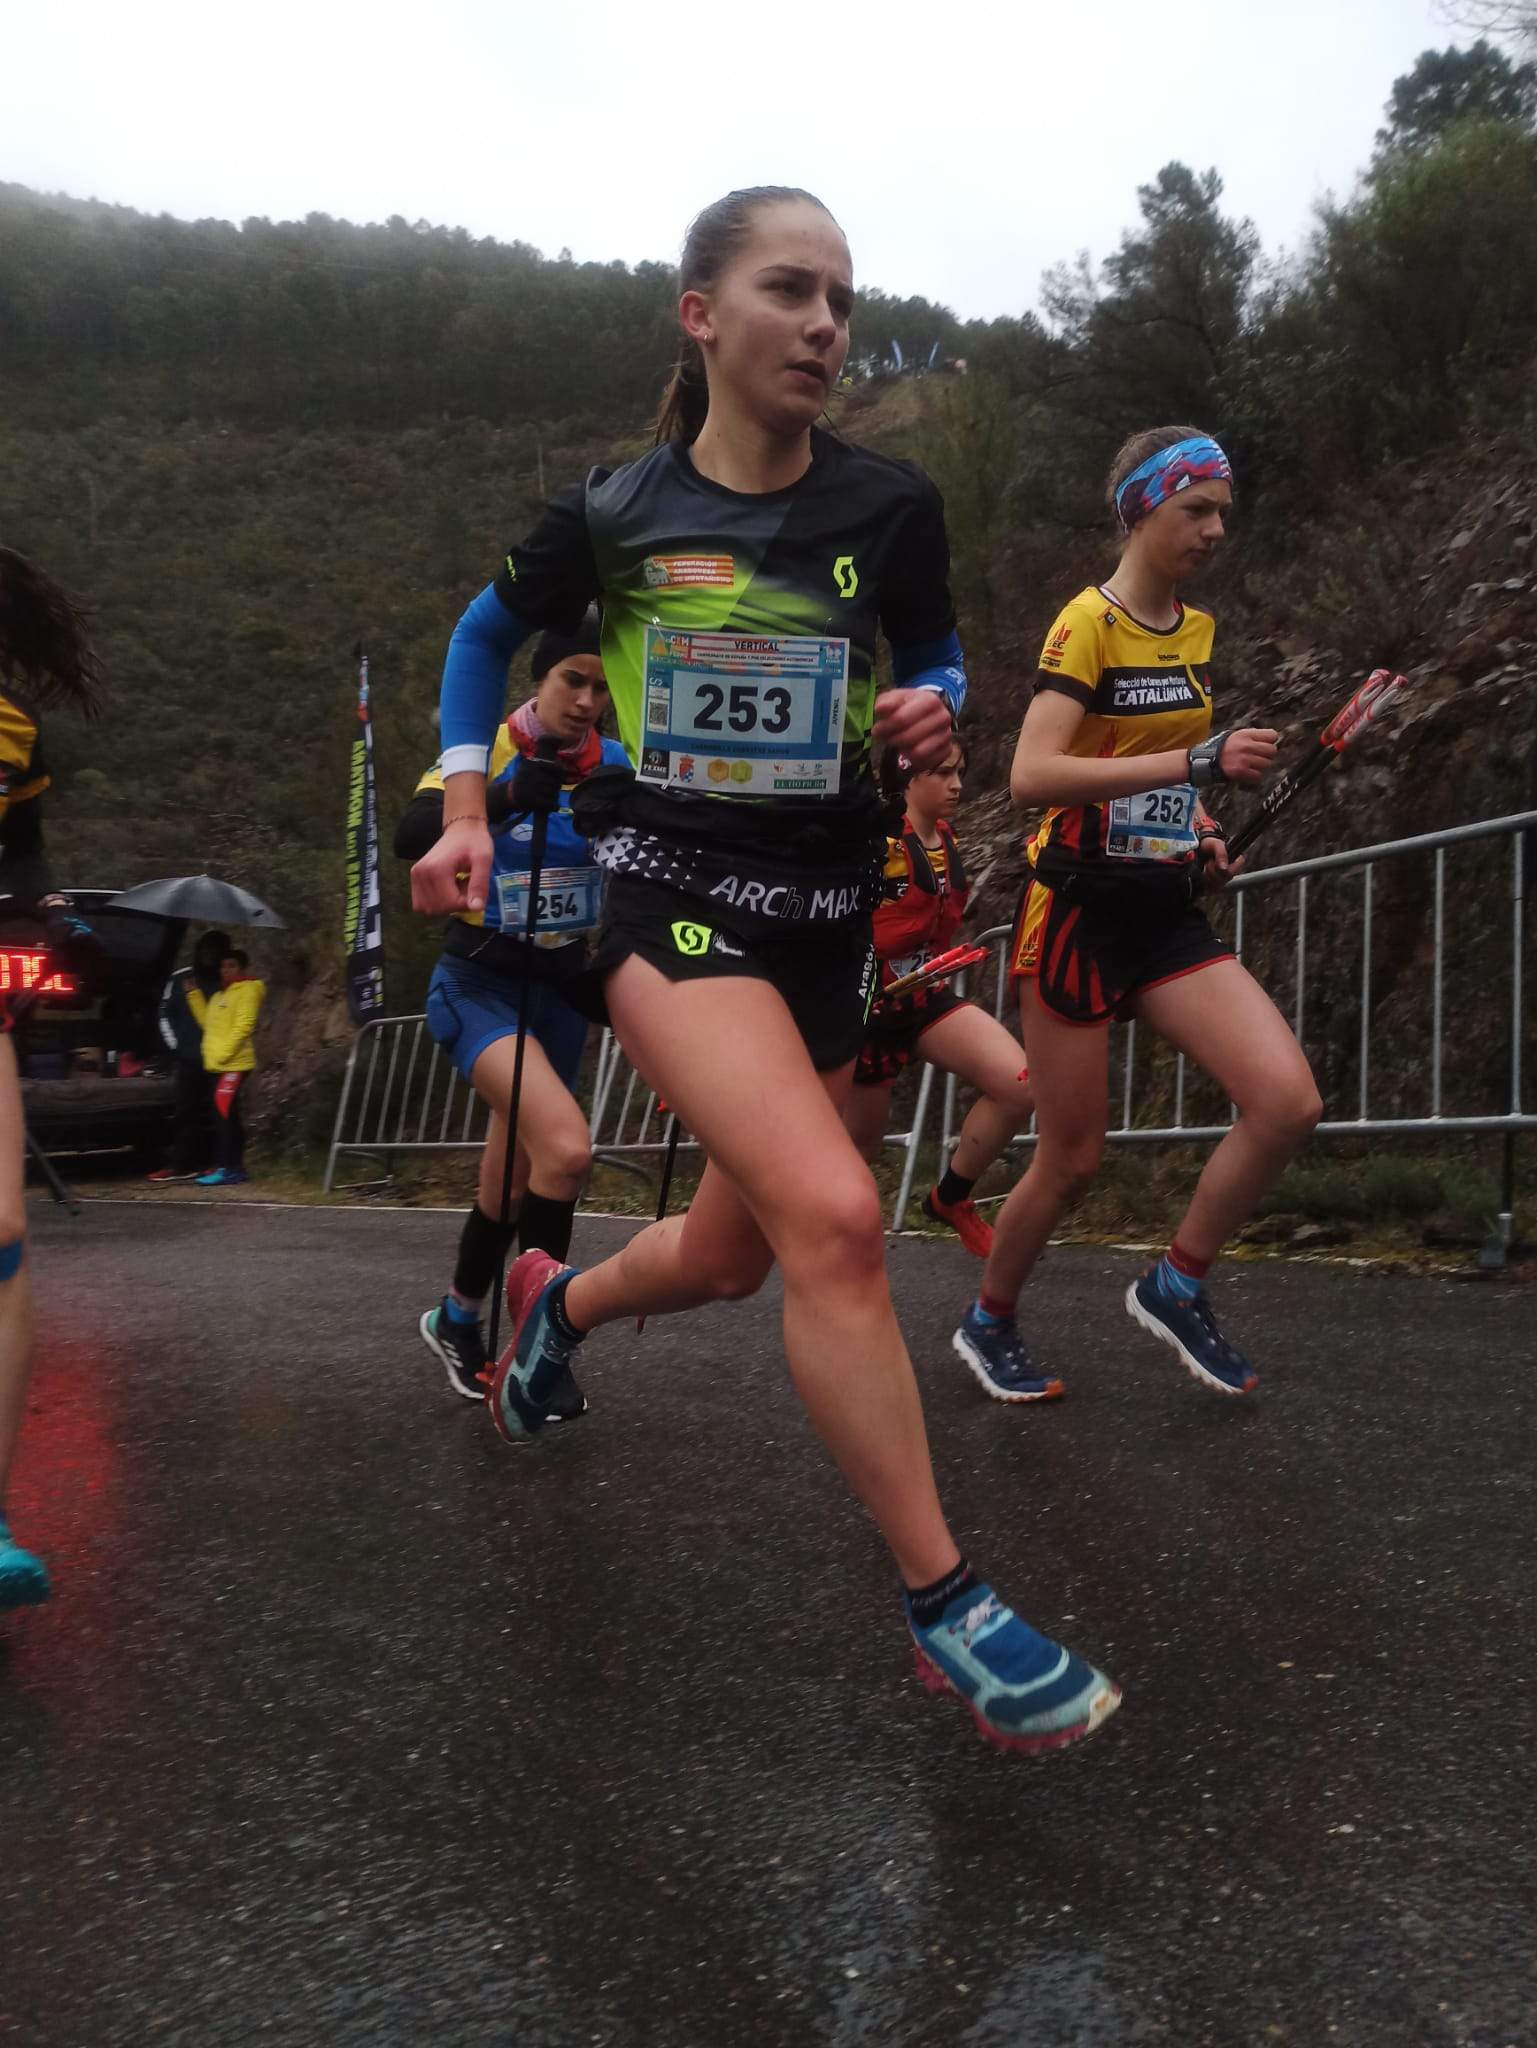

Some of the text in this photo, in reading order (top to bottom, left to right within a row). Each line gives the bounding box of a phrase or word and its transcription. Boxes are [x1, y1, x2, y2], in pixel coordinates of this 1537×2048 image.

[734, 640, 781, 652] VERTICAL
[694, 683, 791, 734] 253
[1113, 686, 1193, 706] CATALUNYA
[1143, 793, 1184, 824] 252
[536, 892, 578, 919] 254
[809, 879, 861, 919] MAX
